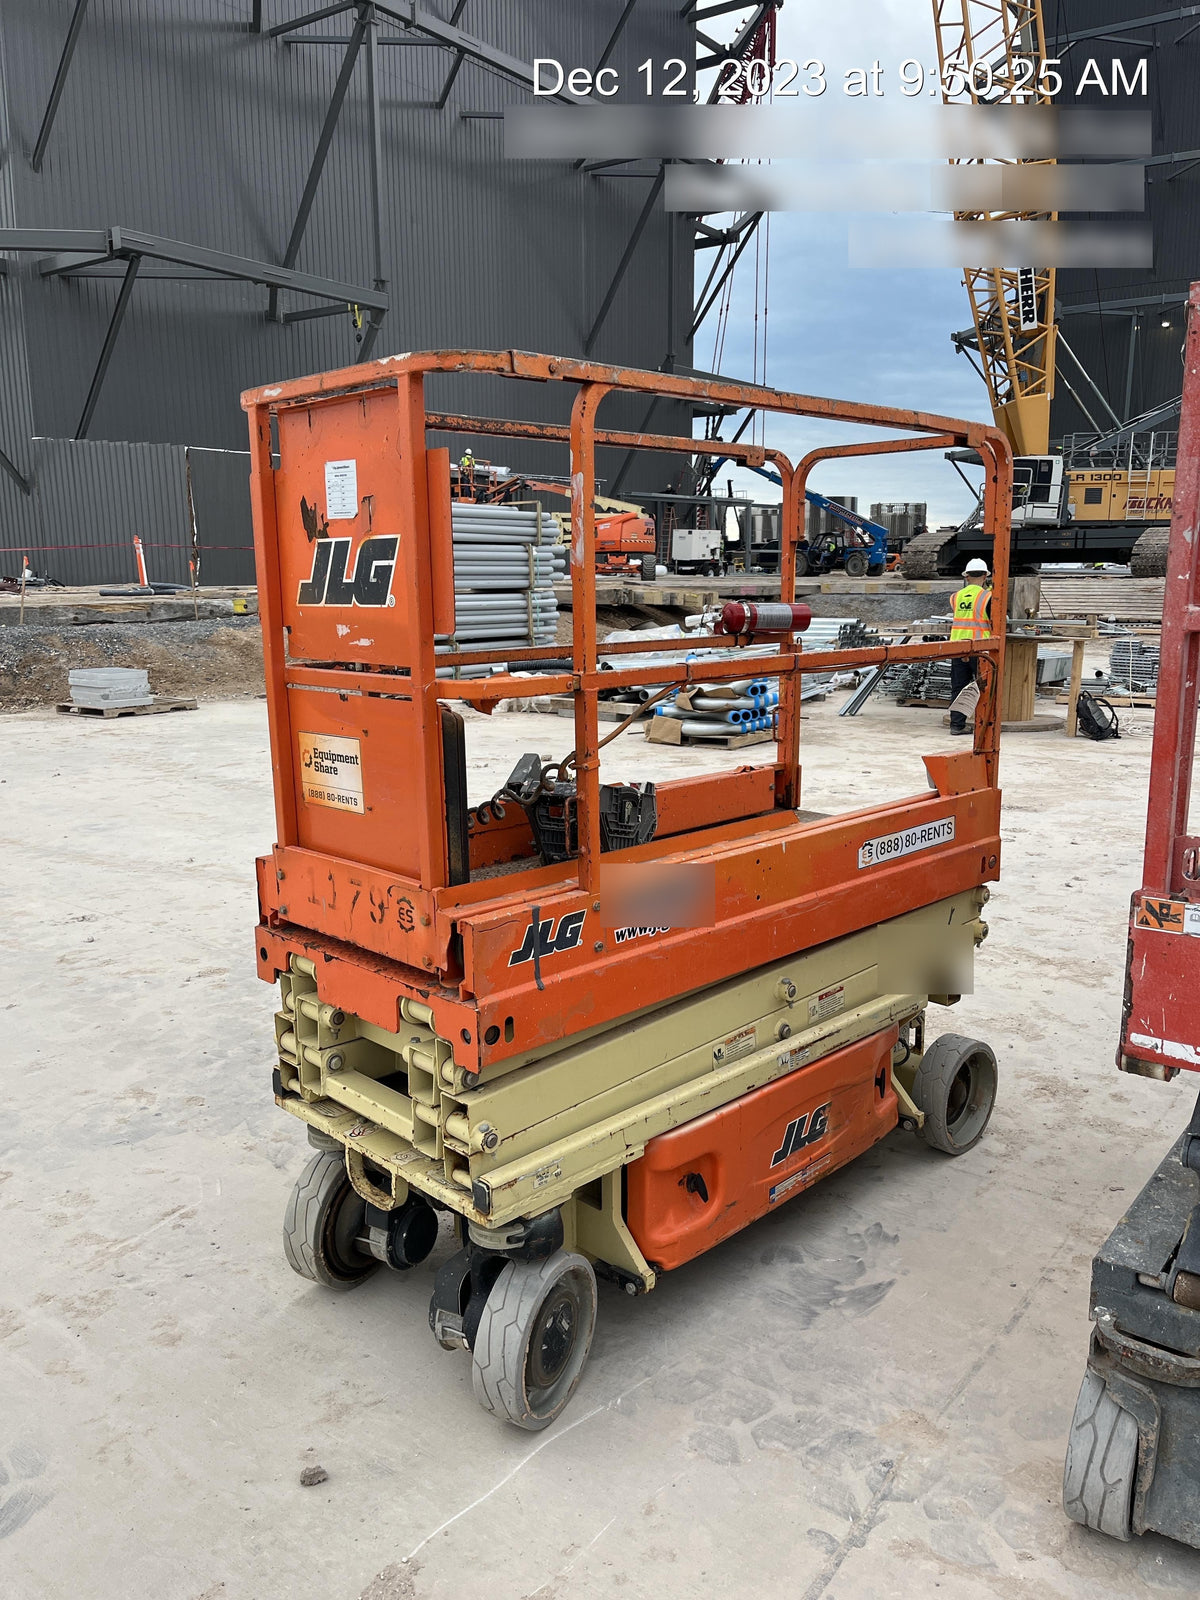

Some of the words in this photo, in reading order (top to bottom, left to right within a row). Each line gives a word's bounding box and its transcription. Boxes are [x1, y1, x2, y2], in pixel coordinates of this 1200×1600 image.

[1090, 473, 1122, 481] 1300
[297, 534, 400, 607] JLG
[313, 748, 359, 765] Equipment
[314, 761, 338, 775] Share
[308, 788, 325, 800] (888)
[327, 793, 358, 806] 80-RENTS
[508, 909, 587, 967] JLG
[770, 1101, 832, 1168] JLG
